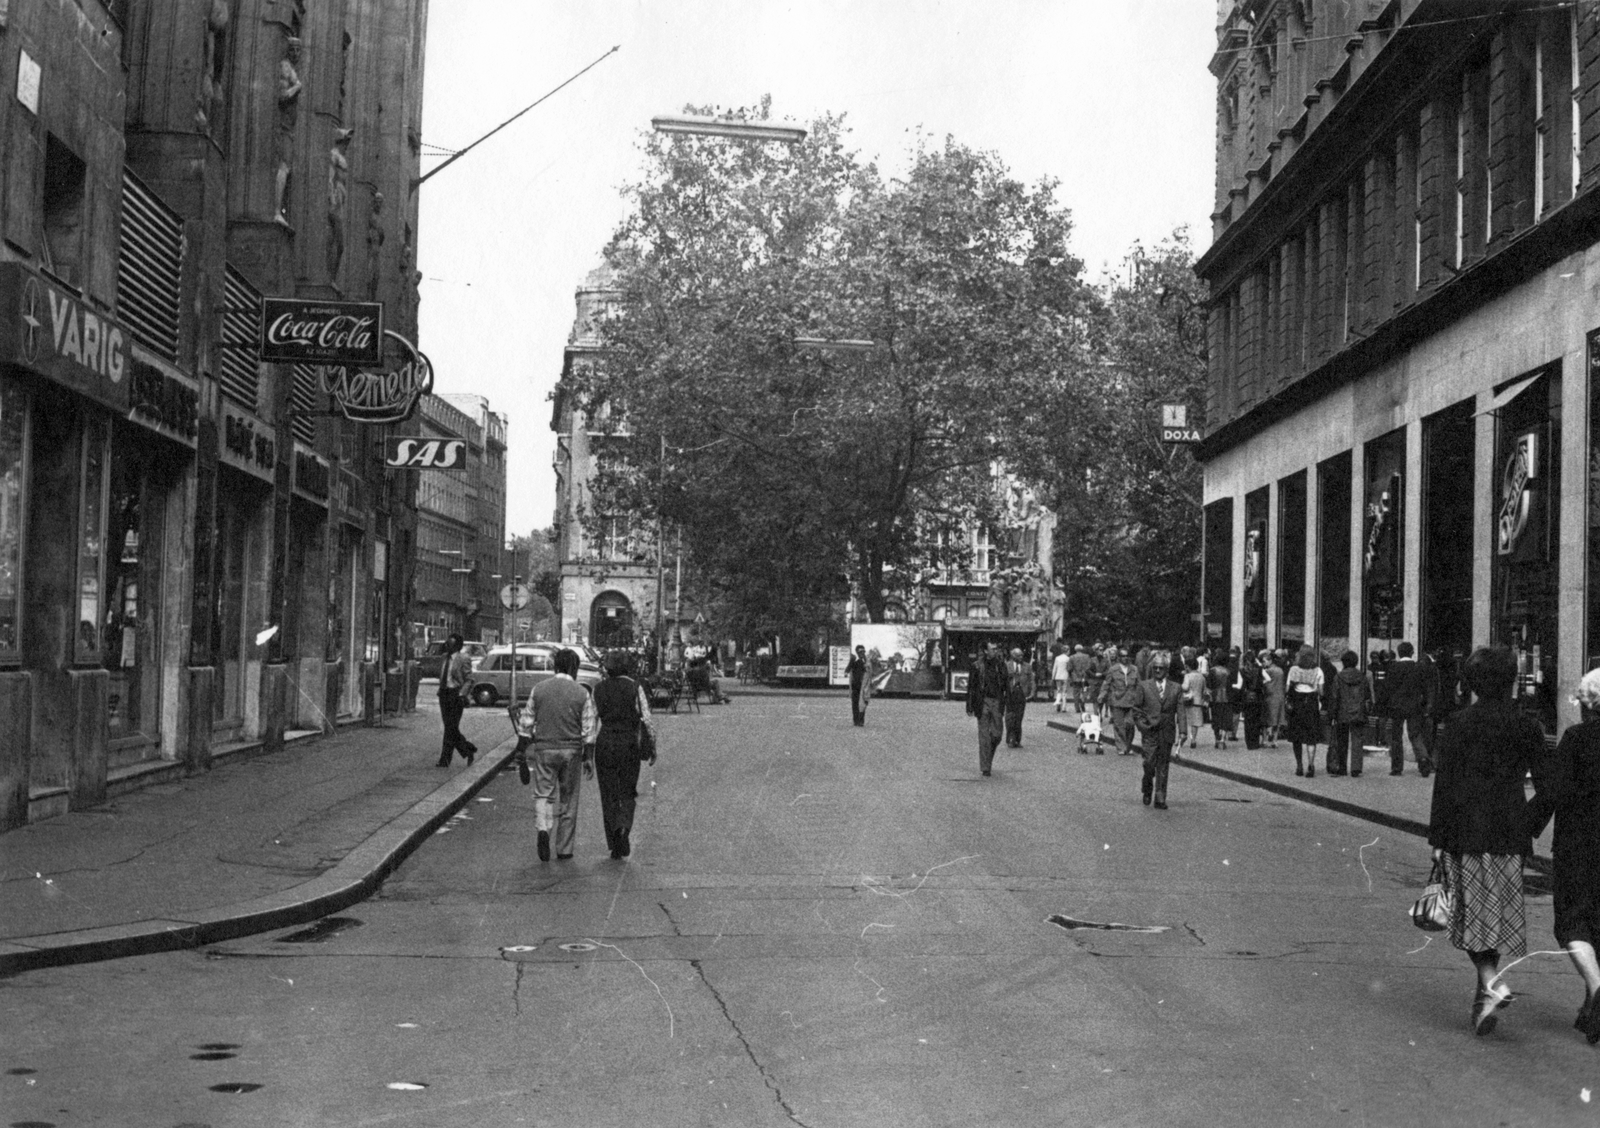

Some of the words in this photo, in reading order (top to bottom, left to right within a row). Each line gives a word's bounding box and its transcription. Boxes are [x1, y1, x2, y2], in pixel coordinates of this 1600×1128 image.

[48, 288, 124, 383] VARIG
[268, 312, 377, 350] Coca-Cola
[1164, 430, 1201, 441] DOXA
[386, 438, 465, 468] SAS
